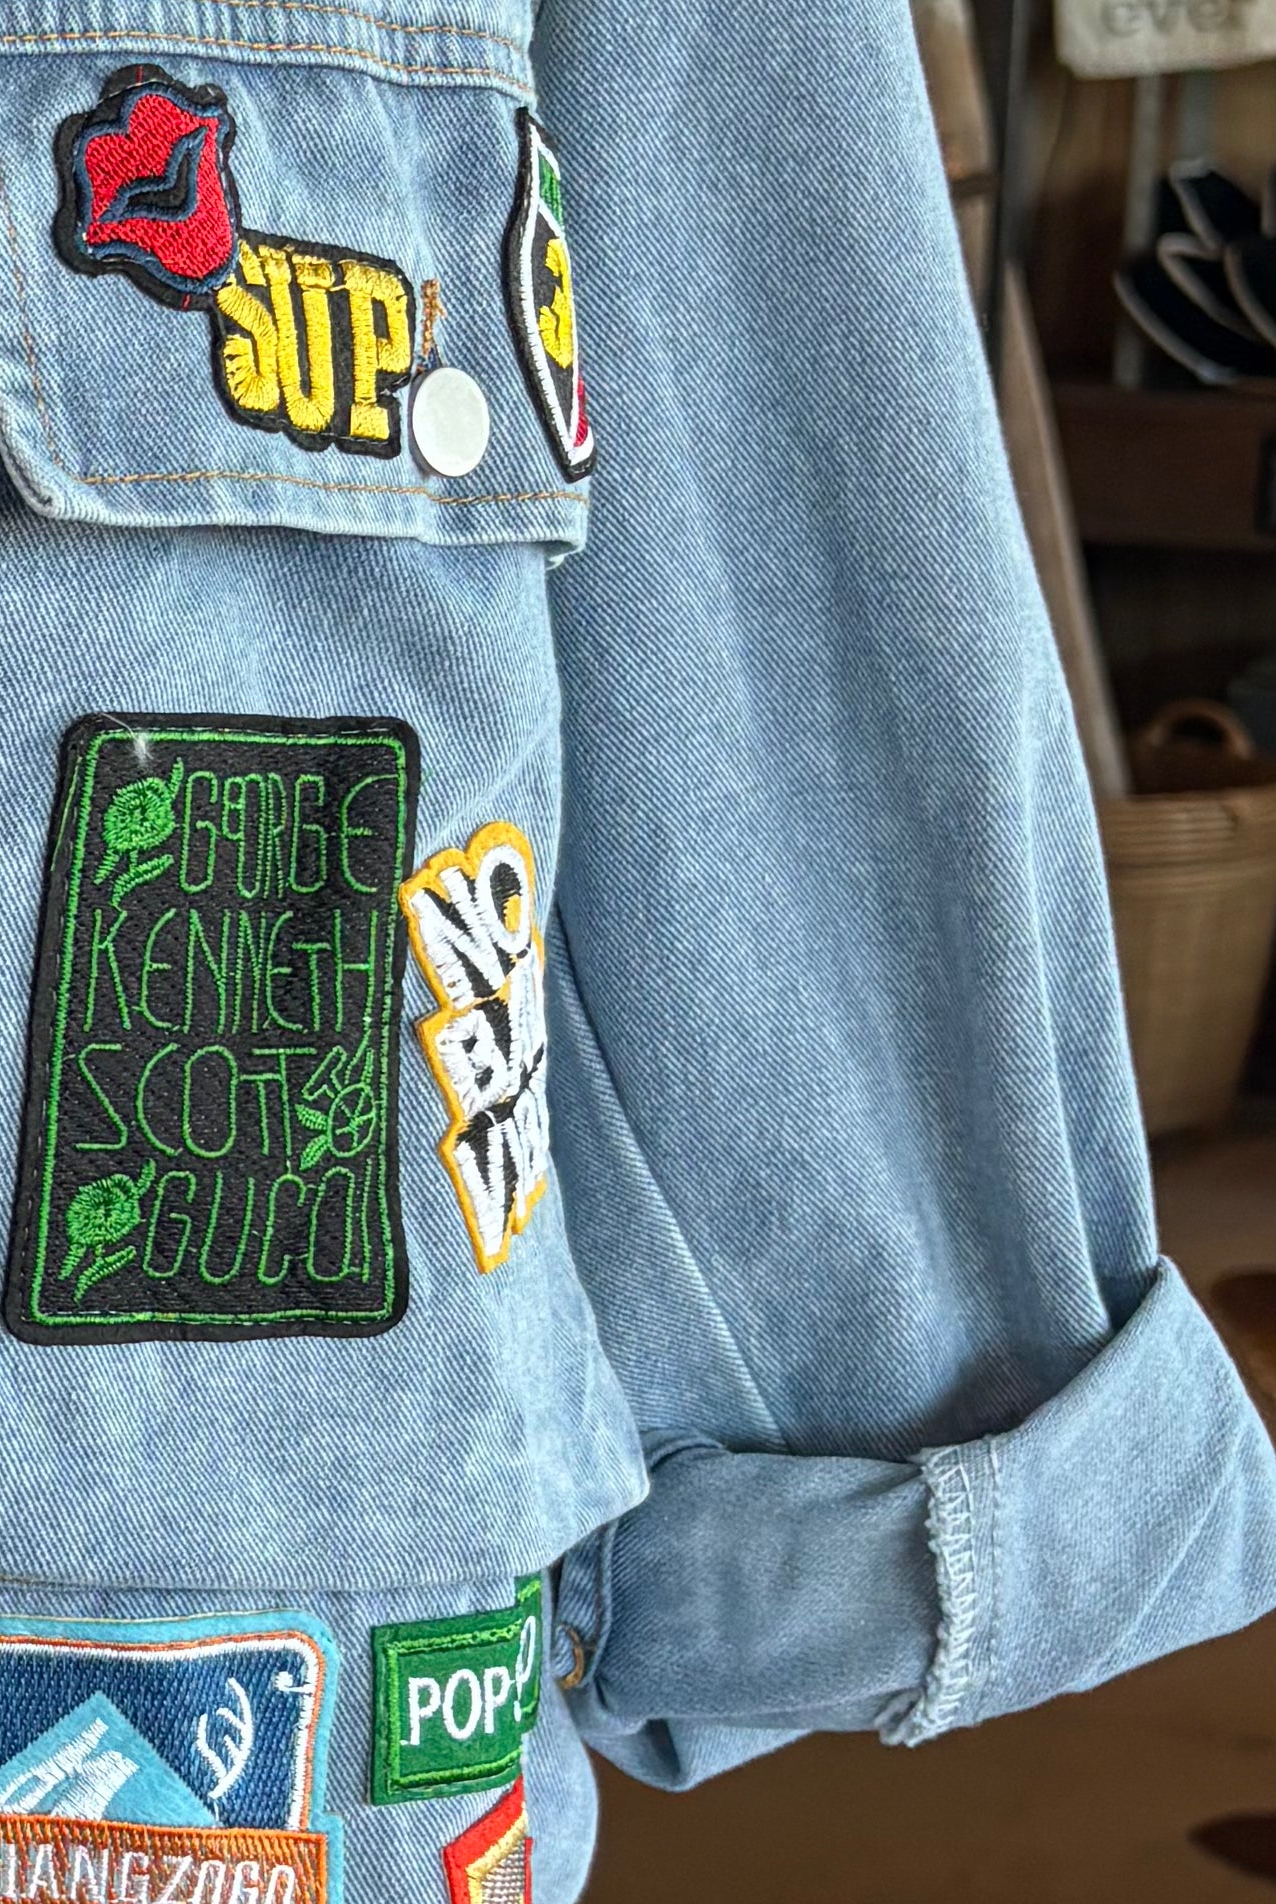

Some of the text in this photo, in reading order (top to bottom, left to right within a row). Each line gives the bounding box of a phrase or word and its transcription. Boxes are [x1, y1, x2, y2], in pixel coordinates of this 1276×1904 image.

[84, 908, 379, 1035] KENNETH
[410, 843, 532, 1010] NO
[75, 1042, 318, 1160] SCOTT
